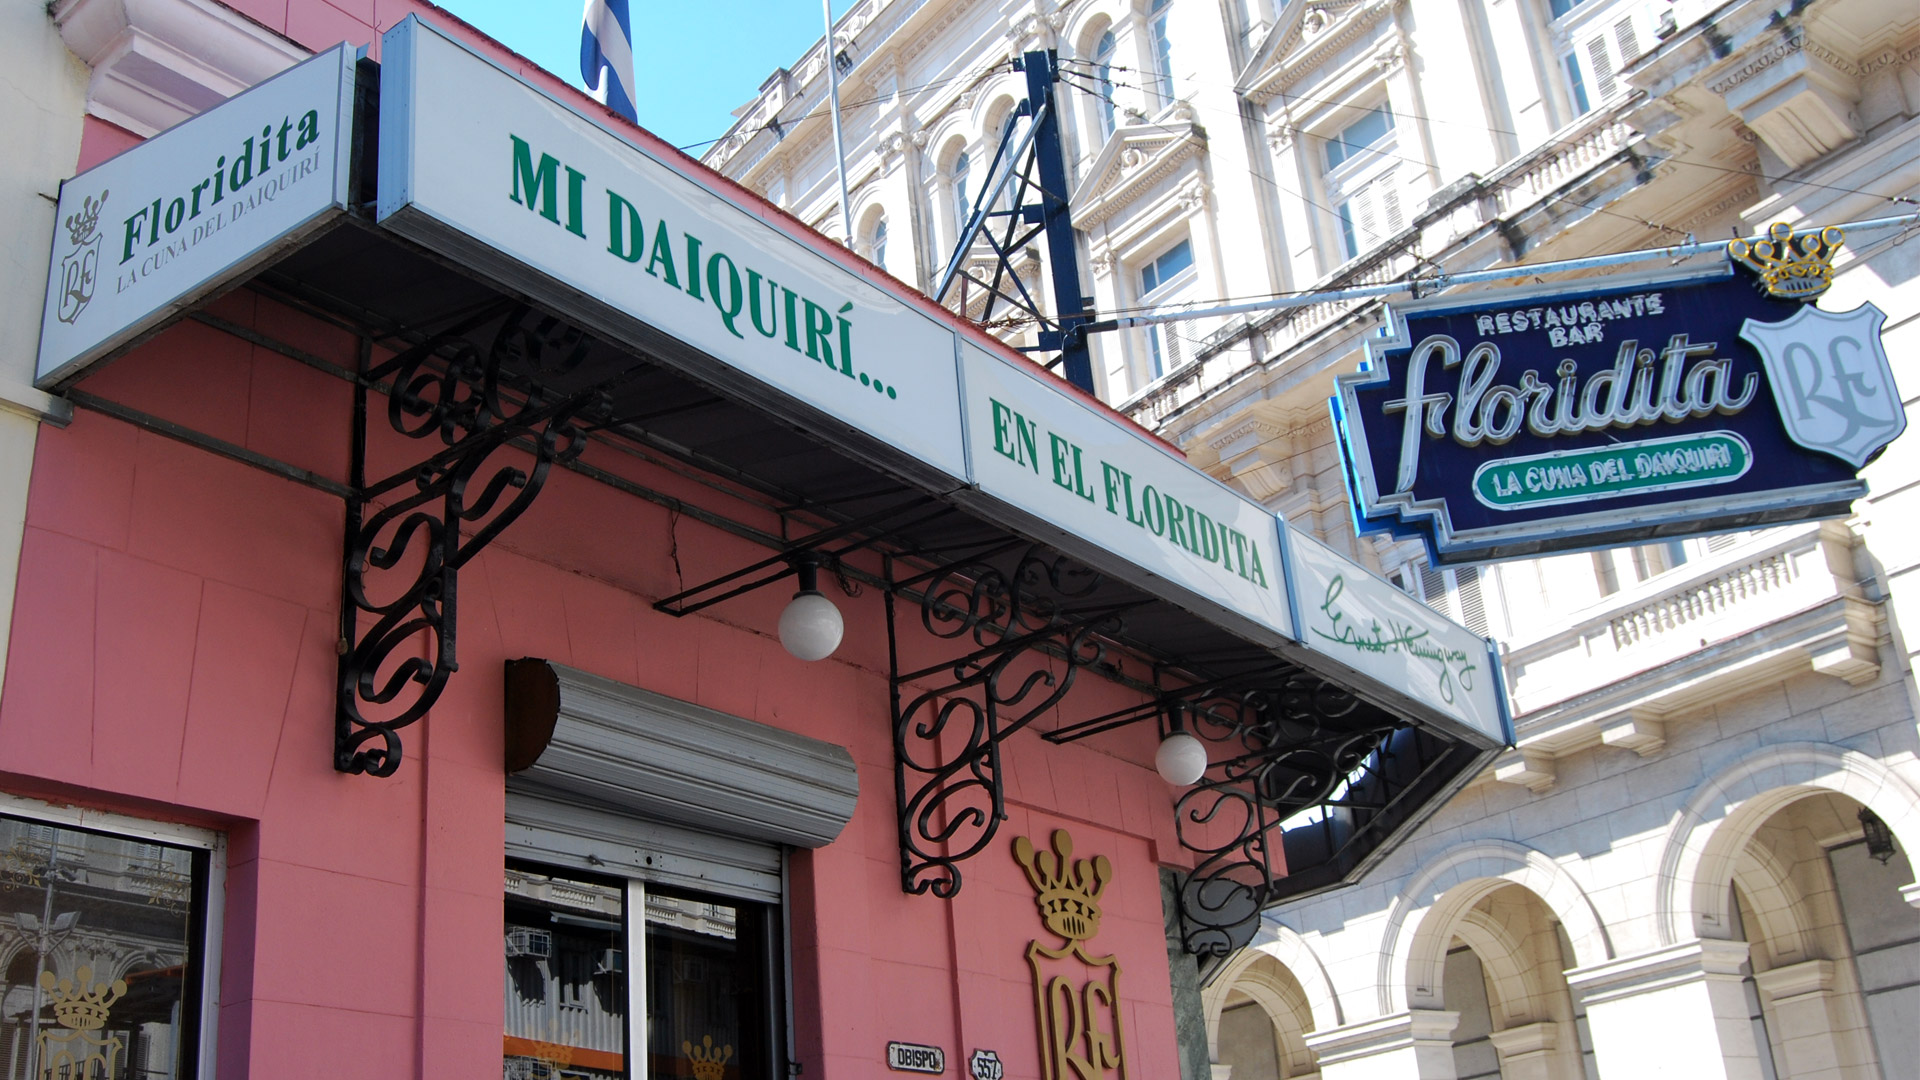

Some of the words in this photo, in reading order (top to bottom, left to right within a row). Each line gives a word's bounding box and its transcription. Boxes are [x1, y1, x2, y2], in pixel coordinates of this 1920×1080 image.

[118, 109, 321, 266] Floridita
[116, 269, 137, 295] LA
[141, 237, 188, 277] CUNA
[191, 212, 228, 247] DEL
[231, 146, 320, 223] DAIQUIRÍ
[509, 133, 588, 240] MI
[606, 187, 898, 401] DAIQUIRÍ...
[1476, 293, 1665, 335] RESTAURANTE
[1549, 321, 1605, 348] BAR
[989, 397, 1040, 476] EN
[1048, 430, 1096, 504] EL
[1100, 460, 1270, 590] FLORIDITA
[1491, 470, 1524, 498] LA
[1525, 462, 1588, 493] CUNA
[1588, 457, 1634, 485] DEL
[897, 1047, 937, 1070] OBISPO
[977, 1057, 997, 1080] 557
